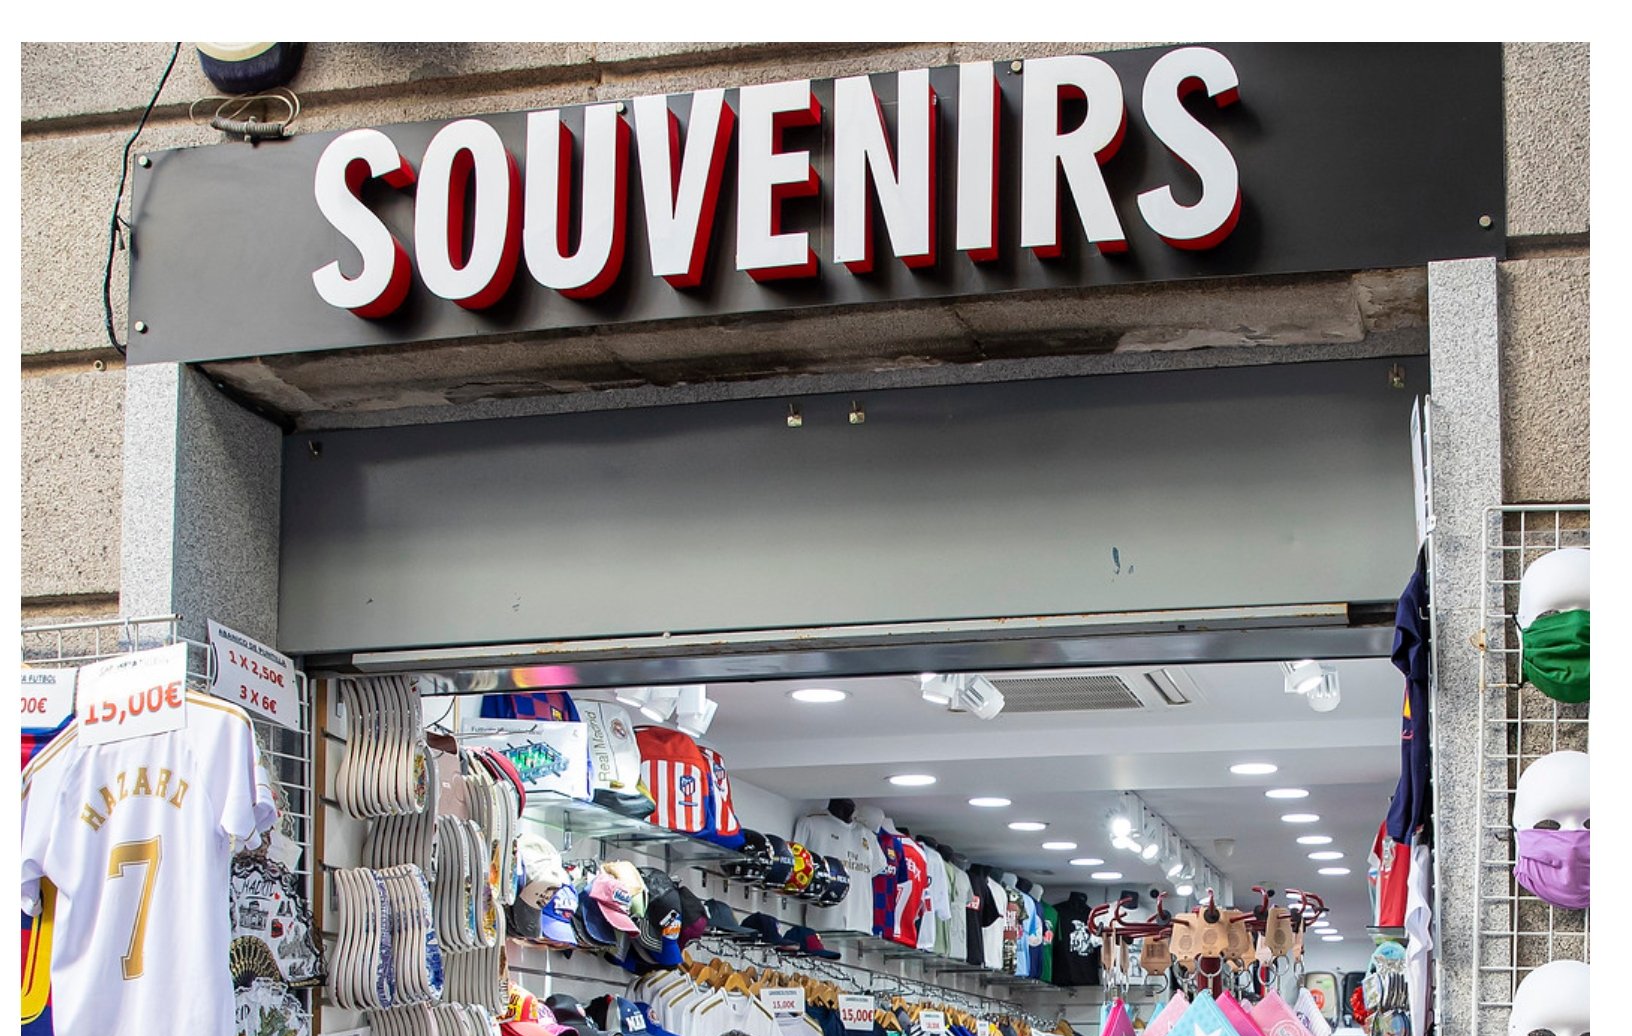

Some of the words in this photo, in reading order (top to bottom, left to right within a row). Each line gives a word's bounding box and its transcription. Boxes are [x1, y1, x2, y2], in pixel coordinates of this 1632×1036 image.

[312, 47, 1242, 318] SOUVENIRS
[28, 674, 56, 684] FUTBOL
[240, 654, 249, 670] X
[251, 660, 285, 688] 2,50€
[84, 680, 183, 726] 15,00€
[240, 685, 247, 699] 3
[250, 689, 259, 706] X
[262, 695, 277, 714] 6€
[80, 767, 189, 830] HAZARD
[107, 834, 163, 981] 7
[842, 1008, 873, 1024] 15,00€
